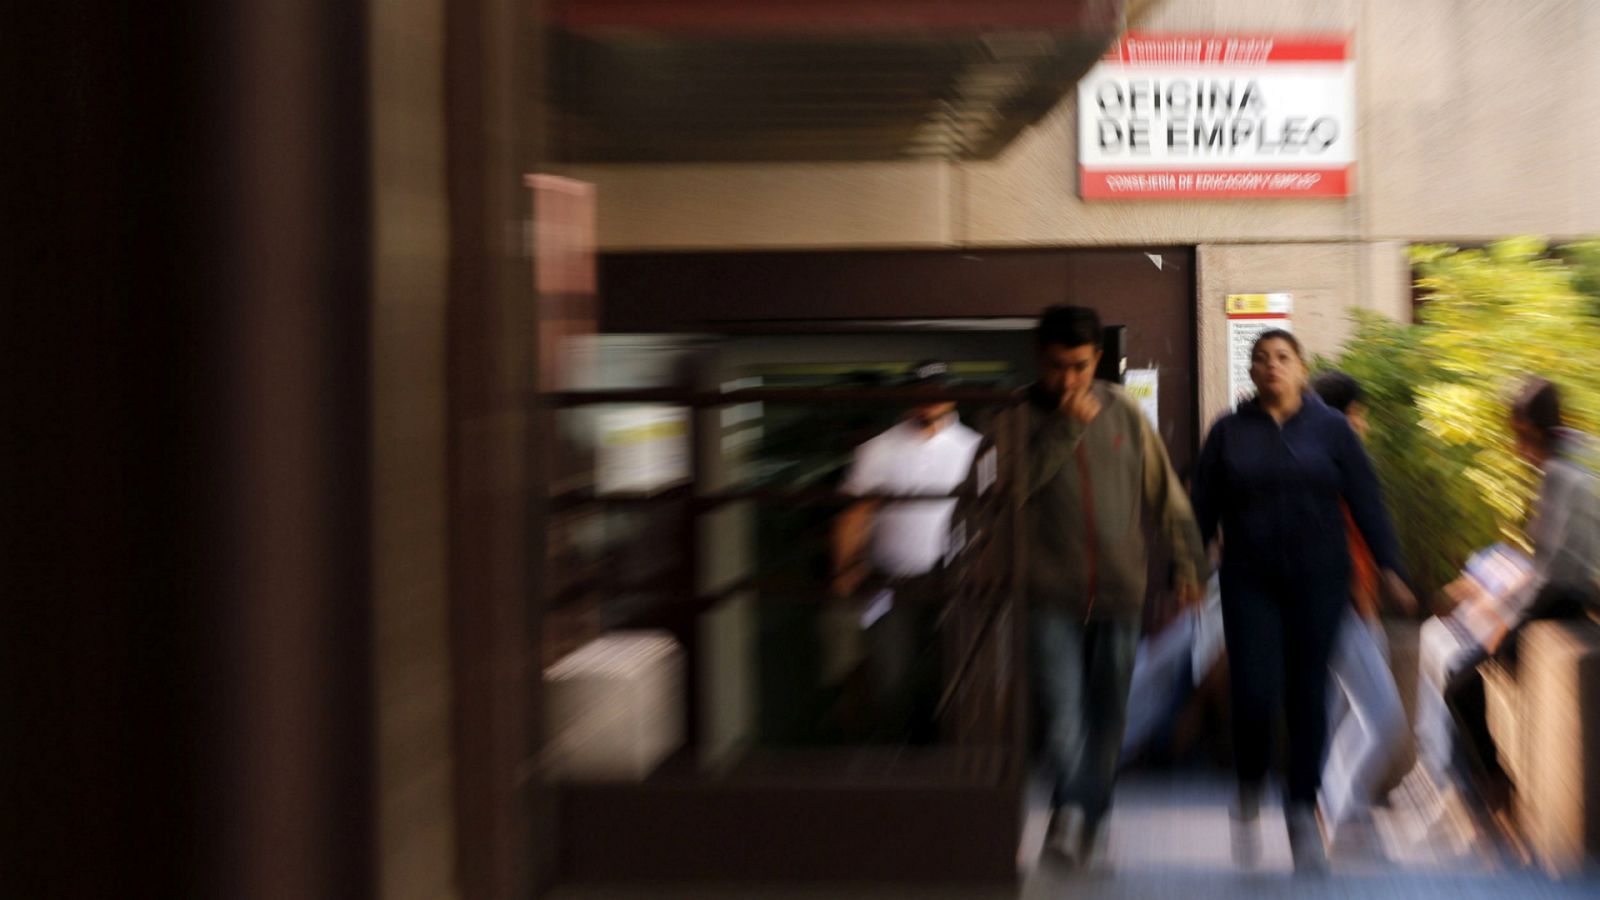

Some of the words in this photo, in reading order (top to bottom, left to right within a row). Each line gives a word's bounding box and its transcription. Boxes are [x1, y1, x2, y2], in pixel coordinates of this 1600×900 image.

[1096, 80, 1266, 116] OFICINA
[1096, 118, 1151, 153] DE
[1166, 117, 1340, 154] EMPLEO
[1178, 175, 1193, 191] DE
